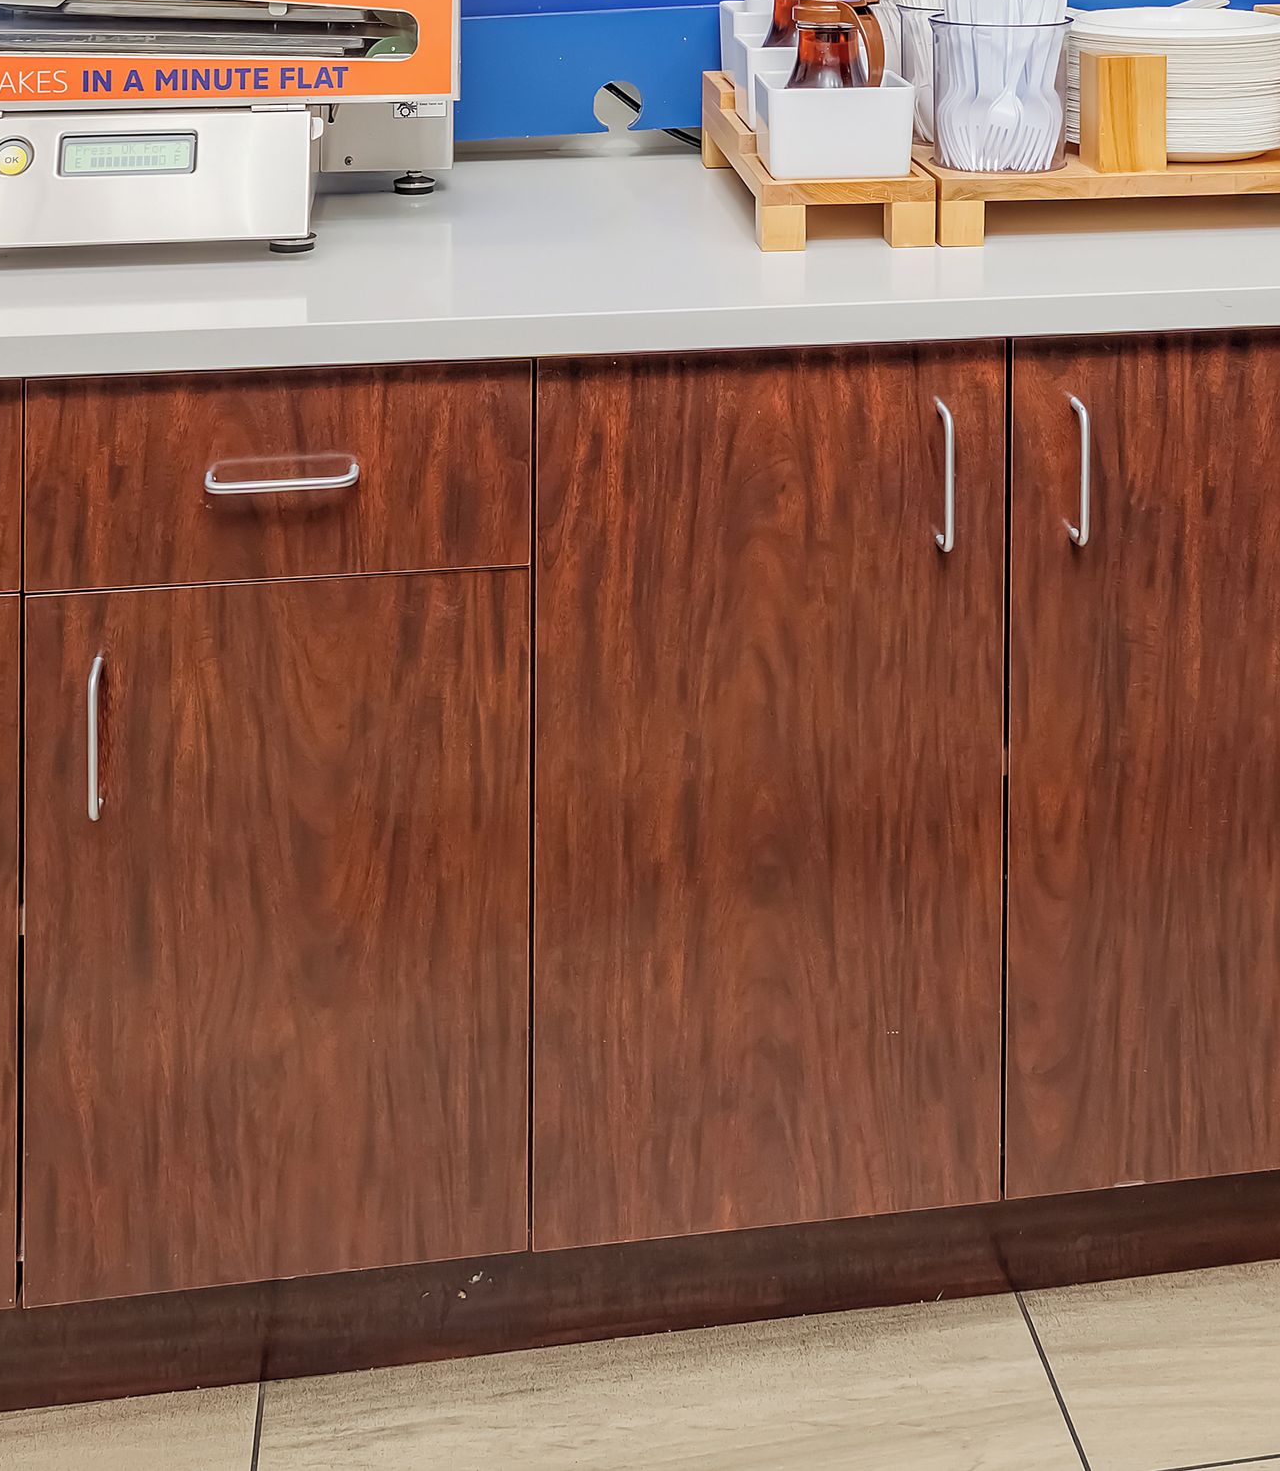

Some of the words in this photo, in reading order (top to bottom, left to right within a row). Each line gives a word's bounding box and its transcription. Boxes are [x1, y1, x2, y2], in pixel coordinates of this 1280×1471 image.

[82, 70, 112, 92] IN
[123, 69, 144, 92] A
[155, 67, 269, 91] MINUTE
[280, 66, 349, 90] FLAT
[75, 144, 112, 156] Press
[121, 143, 136, 155] OK
[144, 142, 166, 154] For
[4, 156, 19, 165] OK
